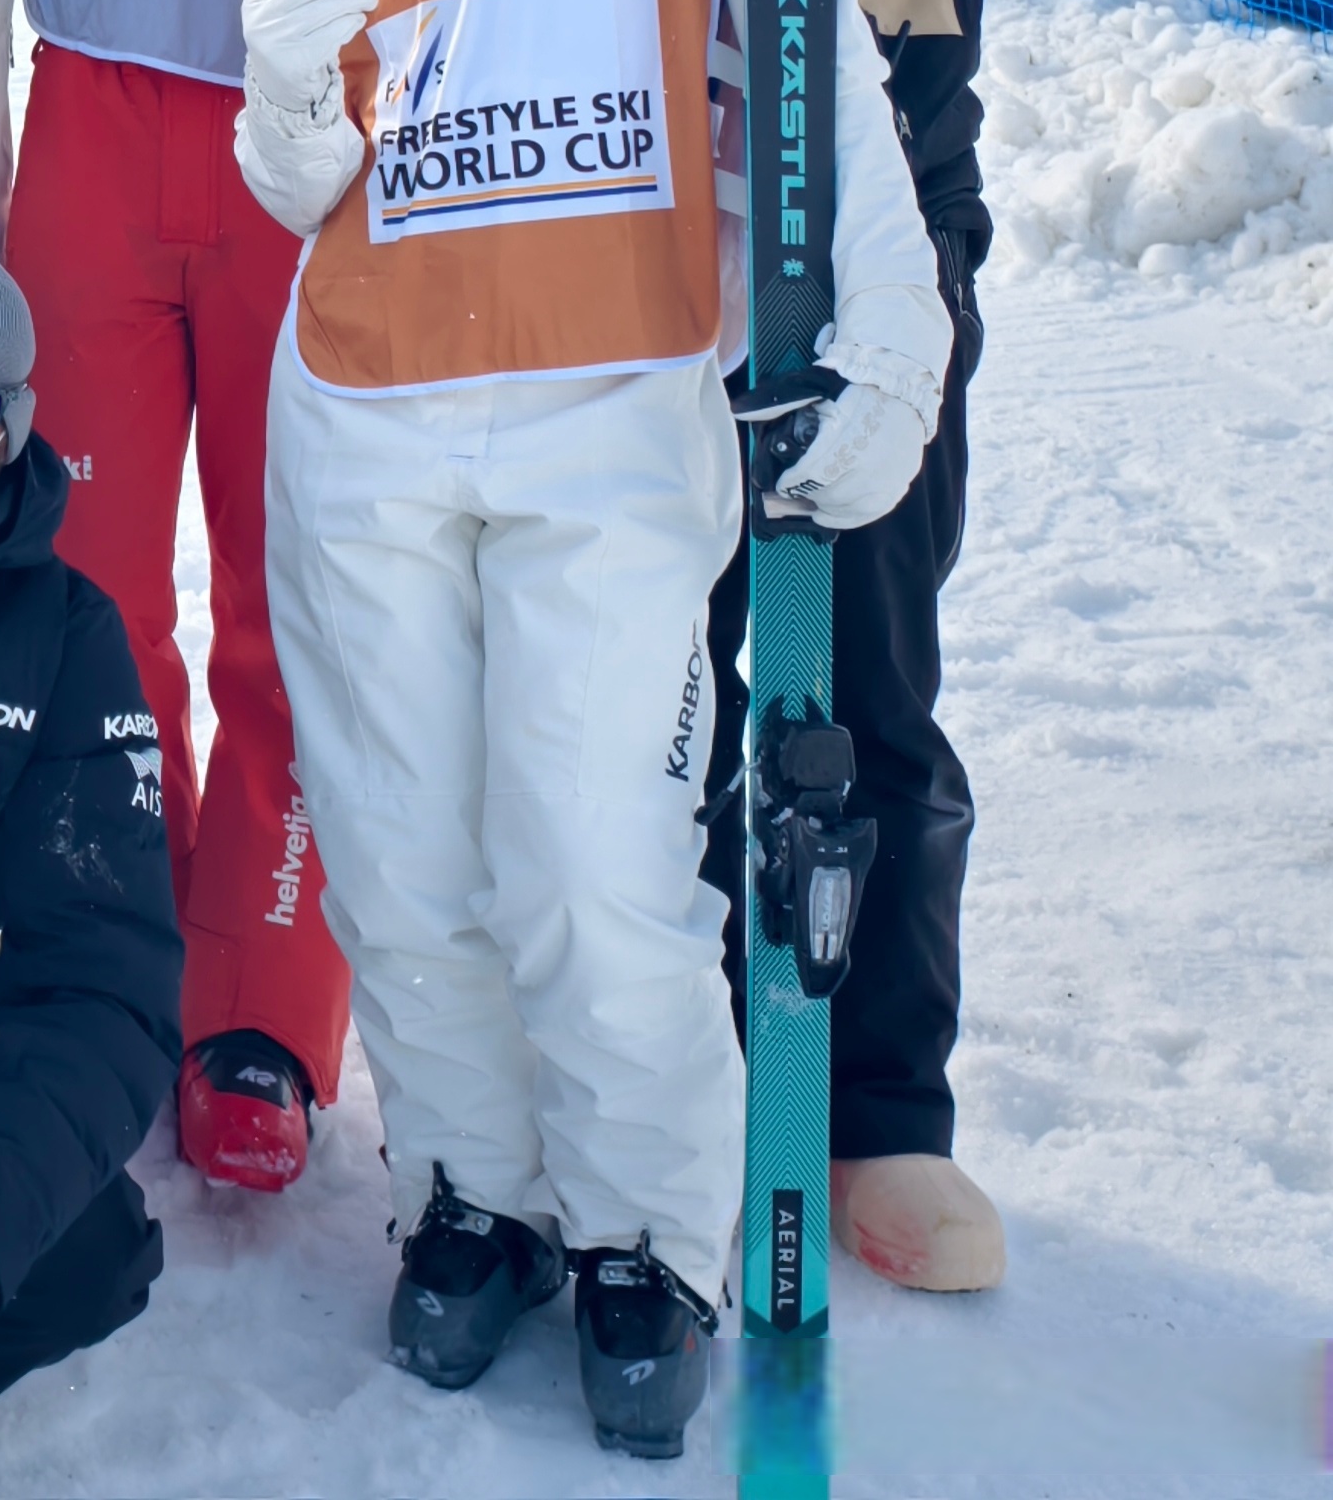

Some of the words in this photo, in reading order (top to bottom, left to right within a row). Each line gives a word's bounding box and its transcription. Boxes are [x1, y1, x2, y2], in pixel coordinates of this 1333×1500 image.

[379, 96, 579, 157] FREESTYLE
[591, 89, 651, 125] SKI
[377, 139, 546, 201] WORLD
[564, 128, 654, 173] CUP
[664, 618, 703, 783] KARBO
[130, 781, 163, 818] AIS
[776, 1208, 797, 1311] AERIAL
